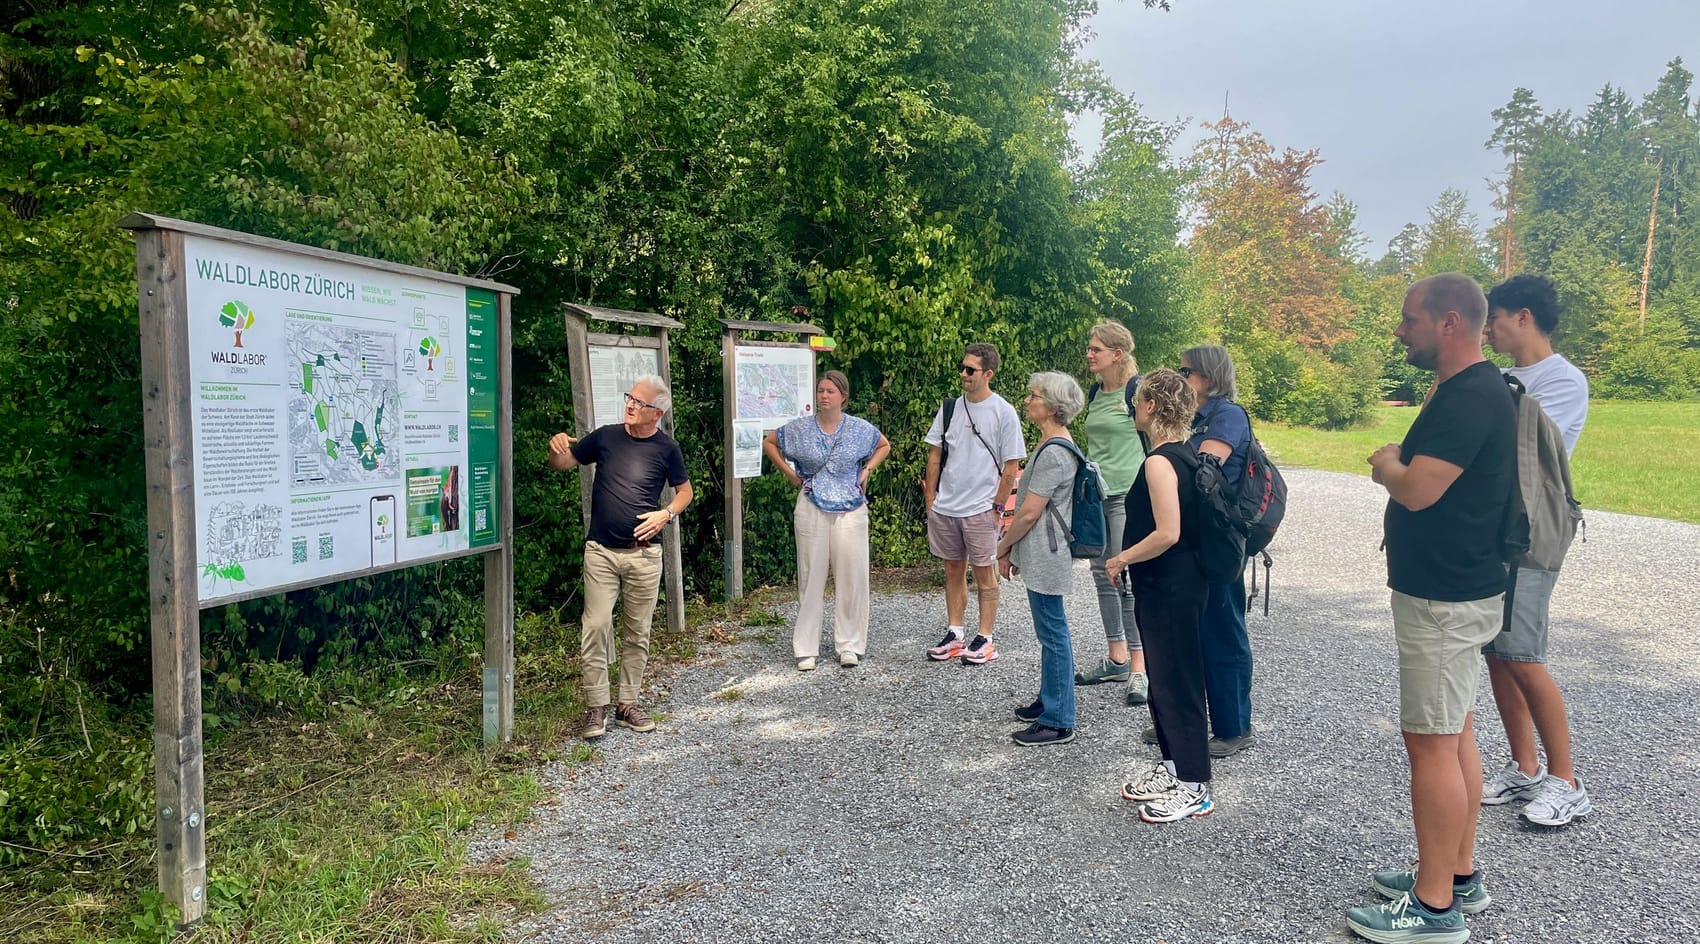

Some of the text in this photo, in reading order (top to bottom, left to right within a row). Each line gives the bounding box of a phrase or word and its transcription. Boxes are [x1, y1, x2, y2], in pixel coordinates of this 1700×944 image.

[195, 258, 355, 300] WALDLABOR ZÜRICH
[1391, 916, 1426, 930] HOKA
